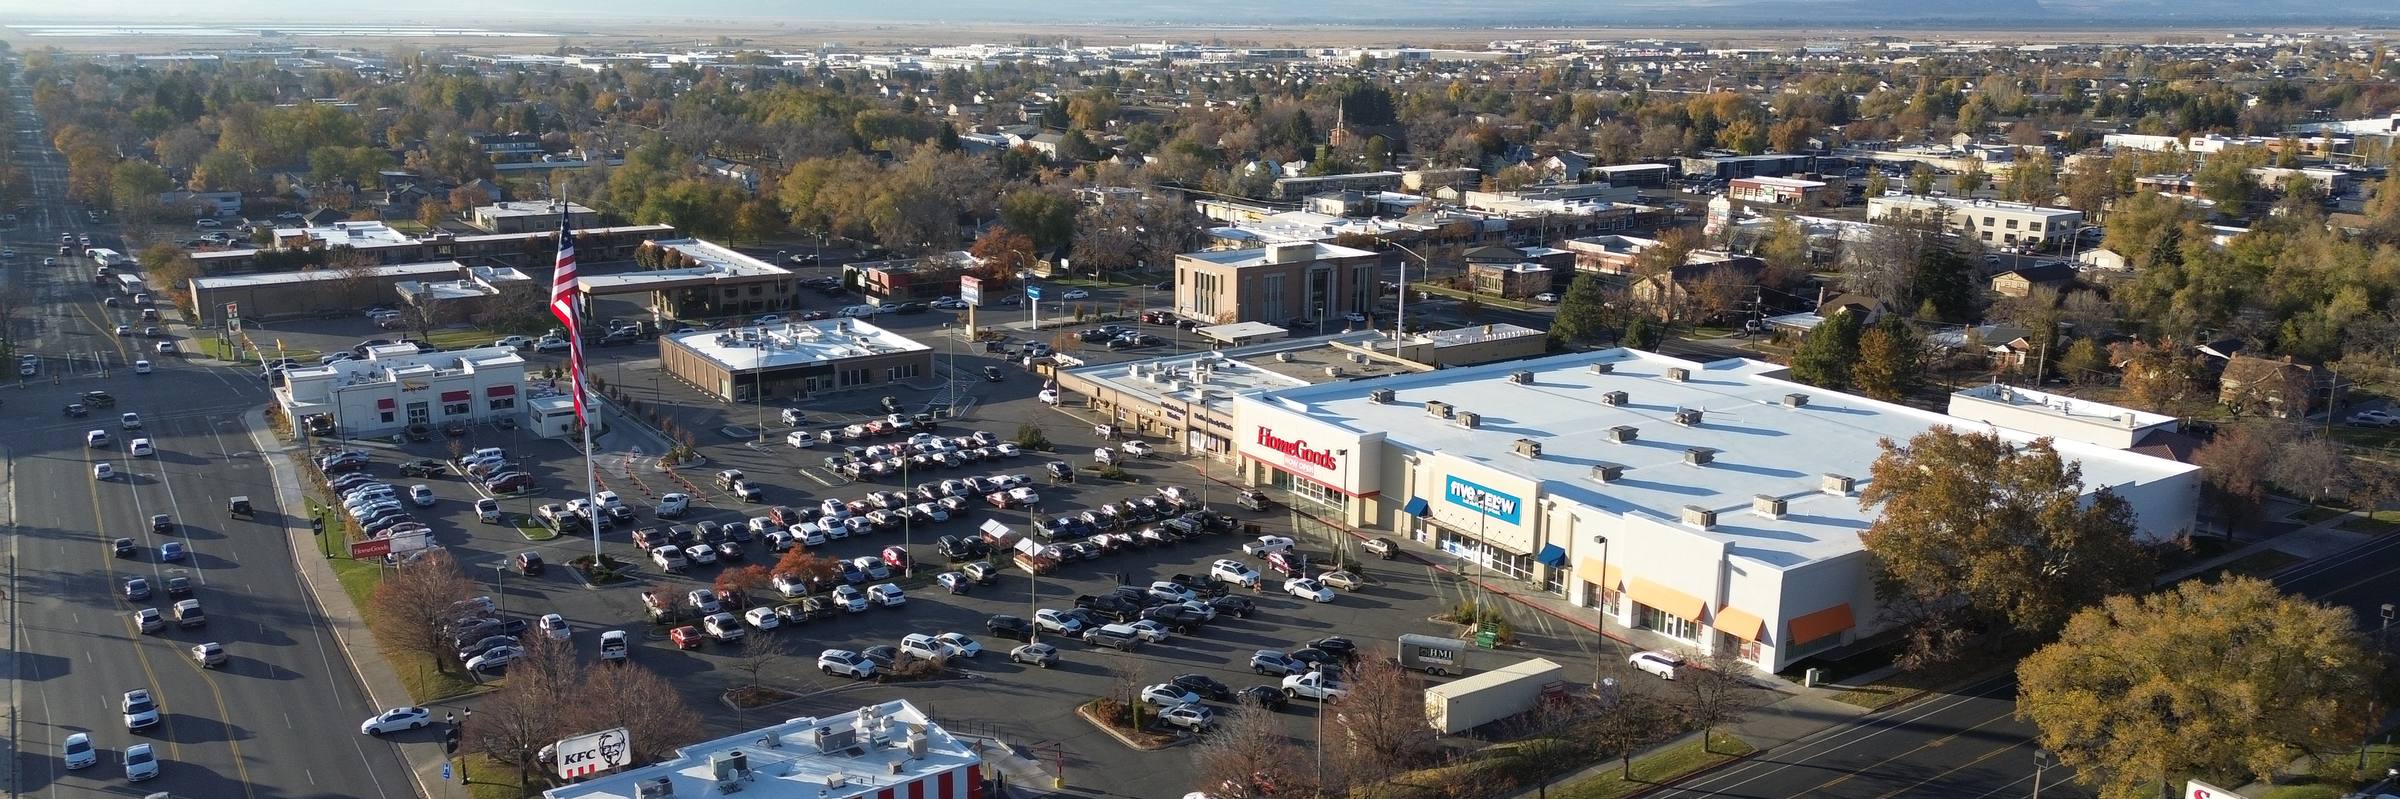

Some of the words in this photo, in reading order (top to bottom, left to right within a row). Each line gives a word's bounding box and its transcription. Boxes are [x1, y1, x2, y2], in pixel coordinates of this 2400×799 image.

[1257, 425, 1336, 471] HomeGoods
[1430, 648, 1452, 658] HMI
[564, 749, 596, 766] KFC
